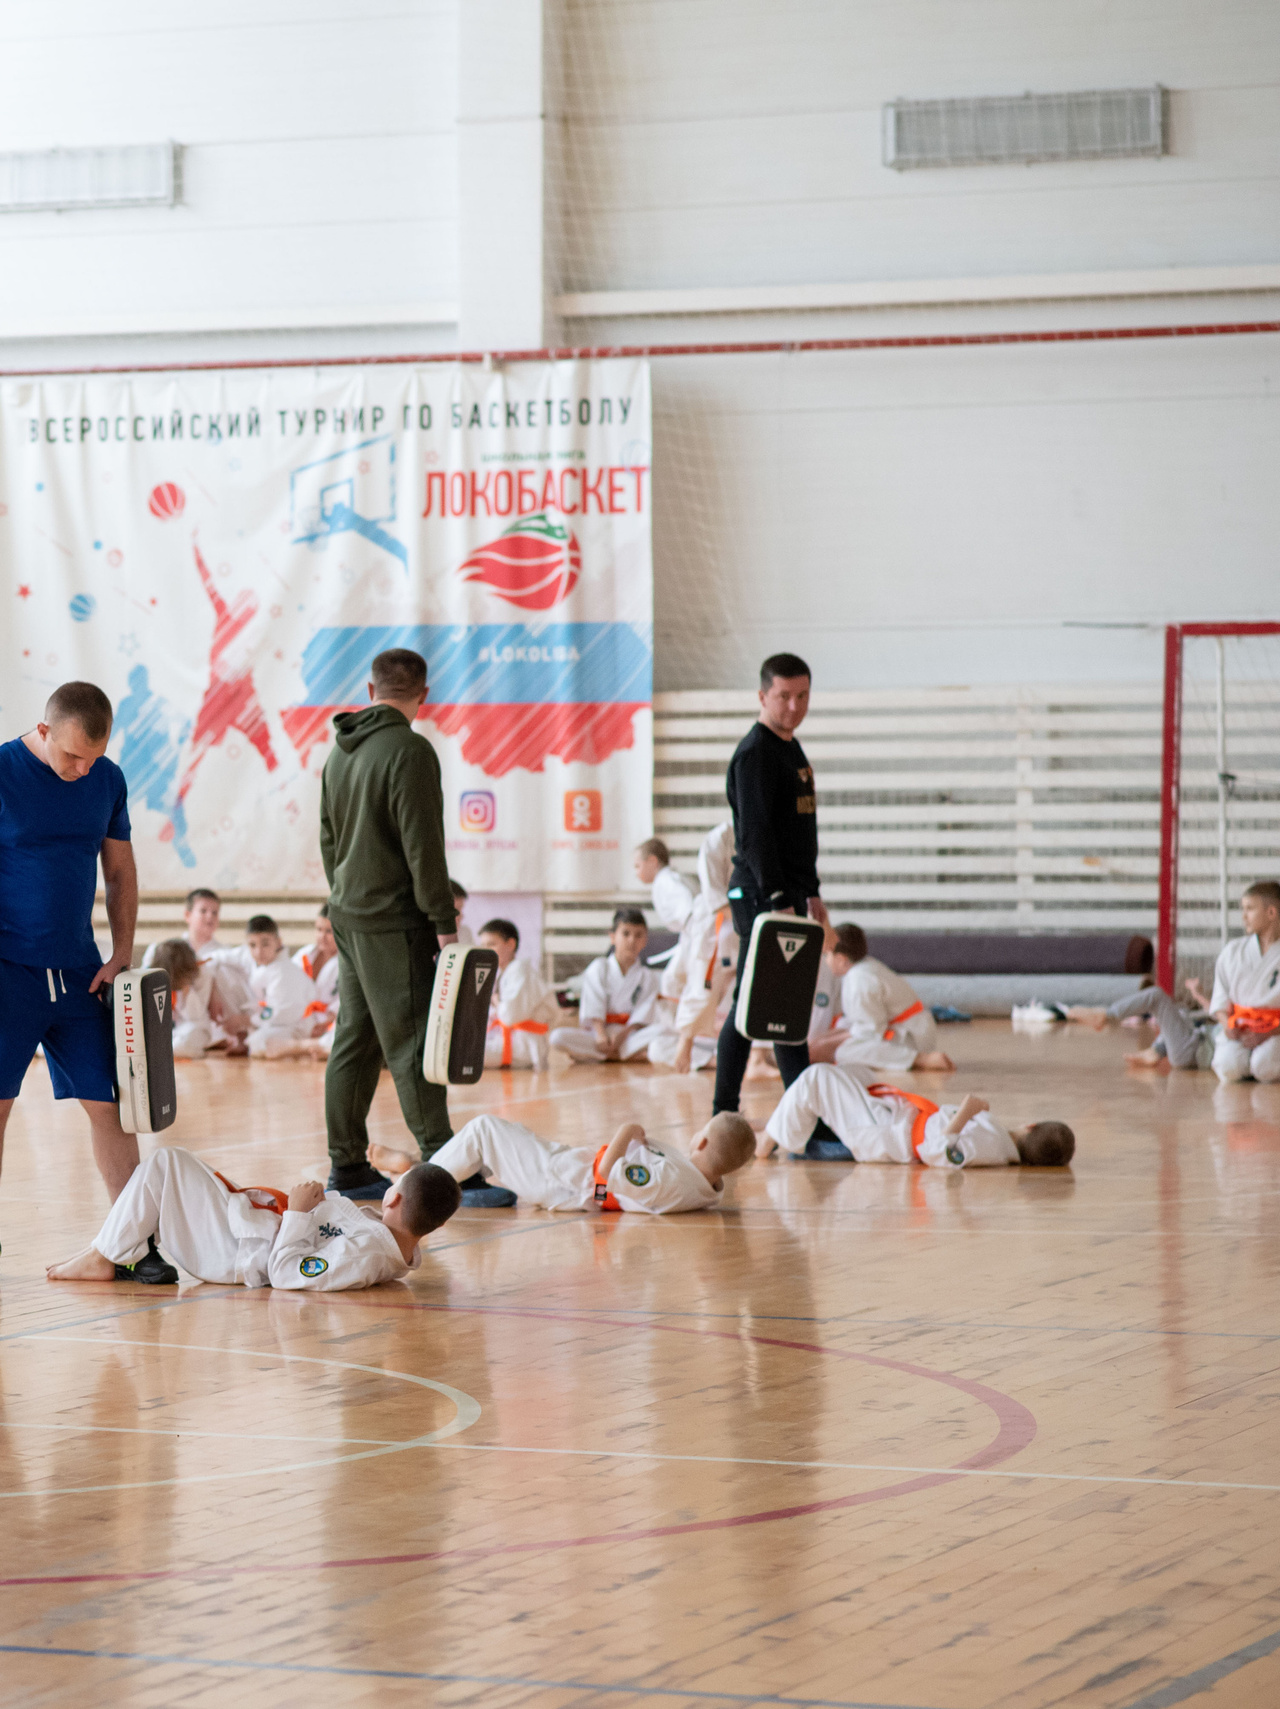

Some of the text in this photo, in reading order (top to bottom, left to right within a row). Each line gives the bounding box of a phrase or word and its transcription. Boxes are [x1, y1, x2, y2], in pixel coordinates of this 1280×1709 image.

[29, 406, 261, 443] ВСЕРОССИЙСКИЙ
[278, 405, 385, 436] ТУРНИР
[451, 397, 632, 429] БАСКЕТБОЛУ
[422, 465, 650, 519] ЛОКОБАСКЕТ
[439, 953, 456, 1010] FIGHTUS
[123, 982, 135, 1053] FIGHTUS
[767, 1022, 787, 1033] BAX
